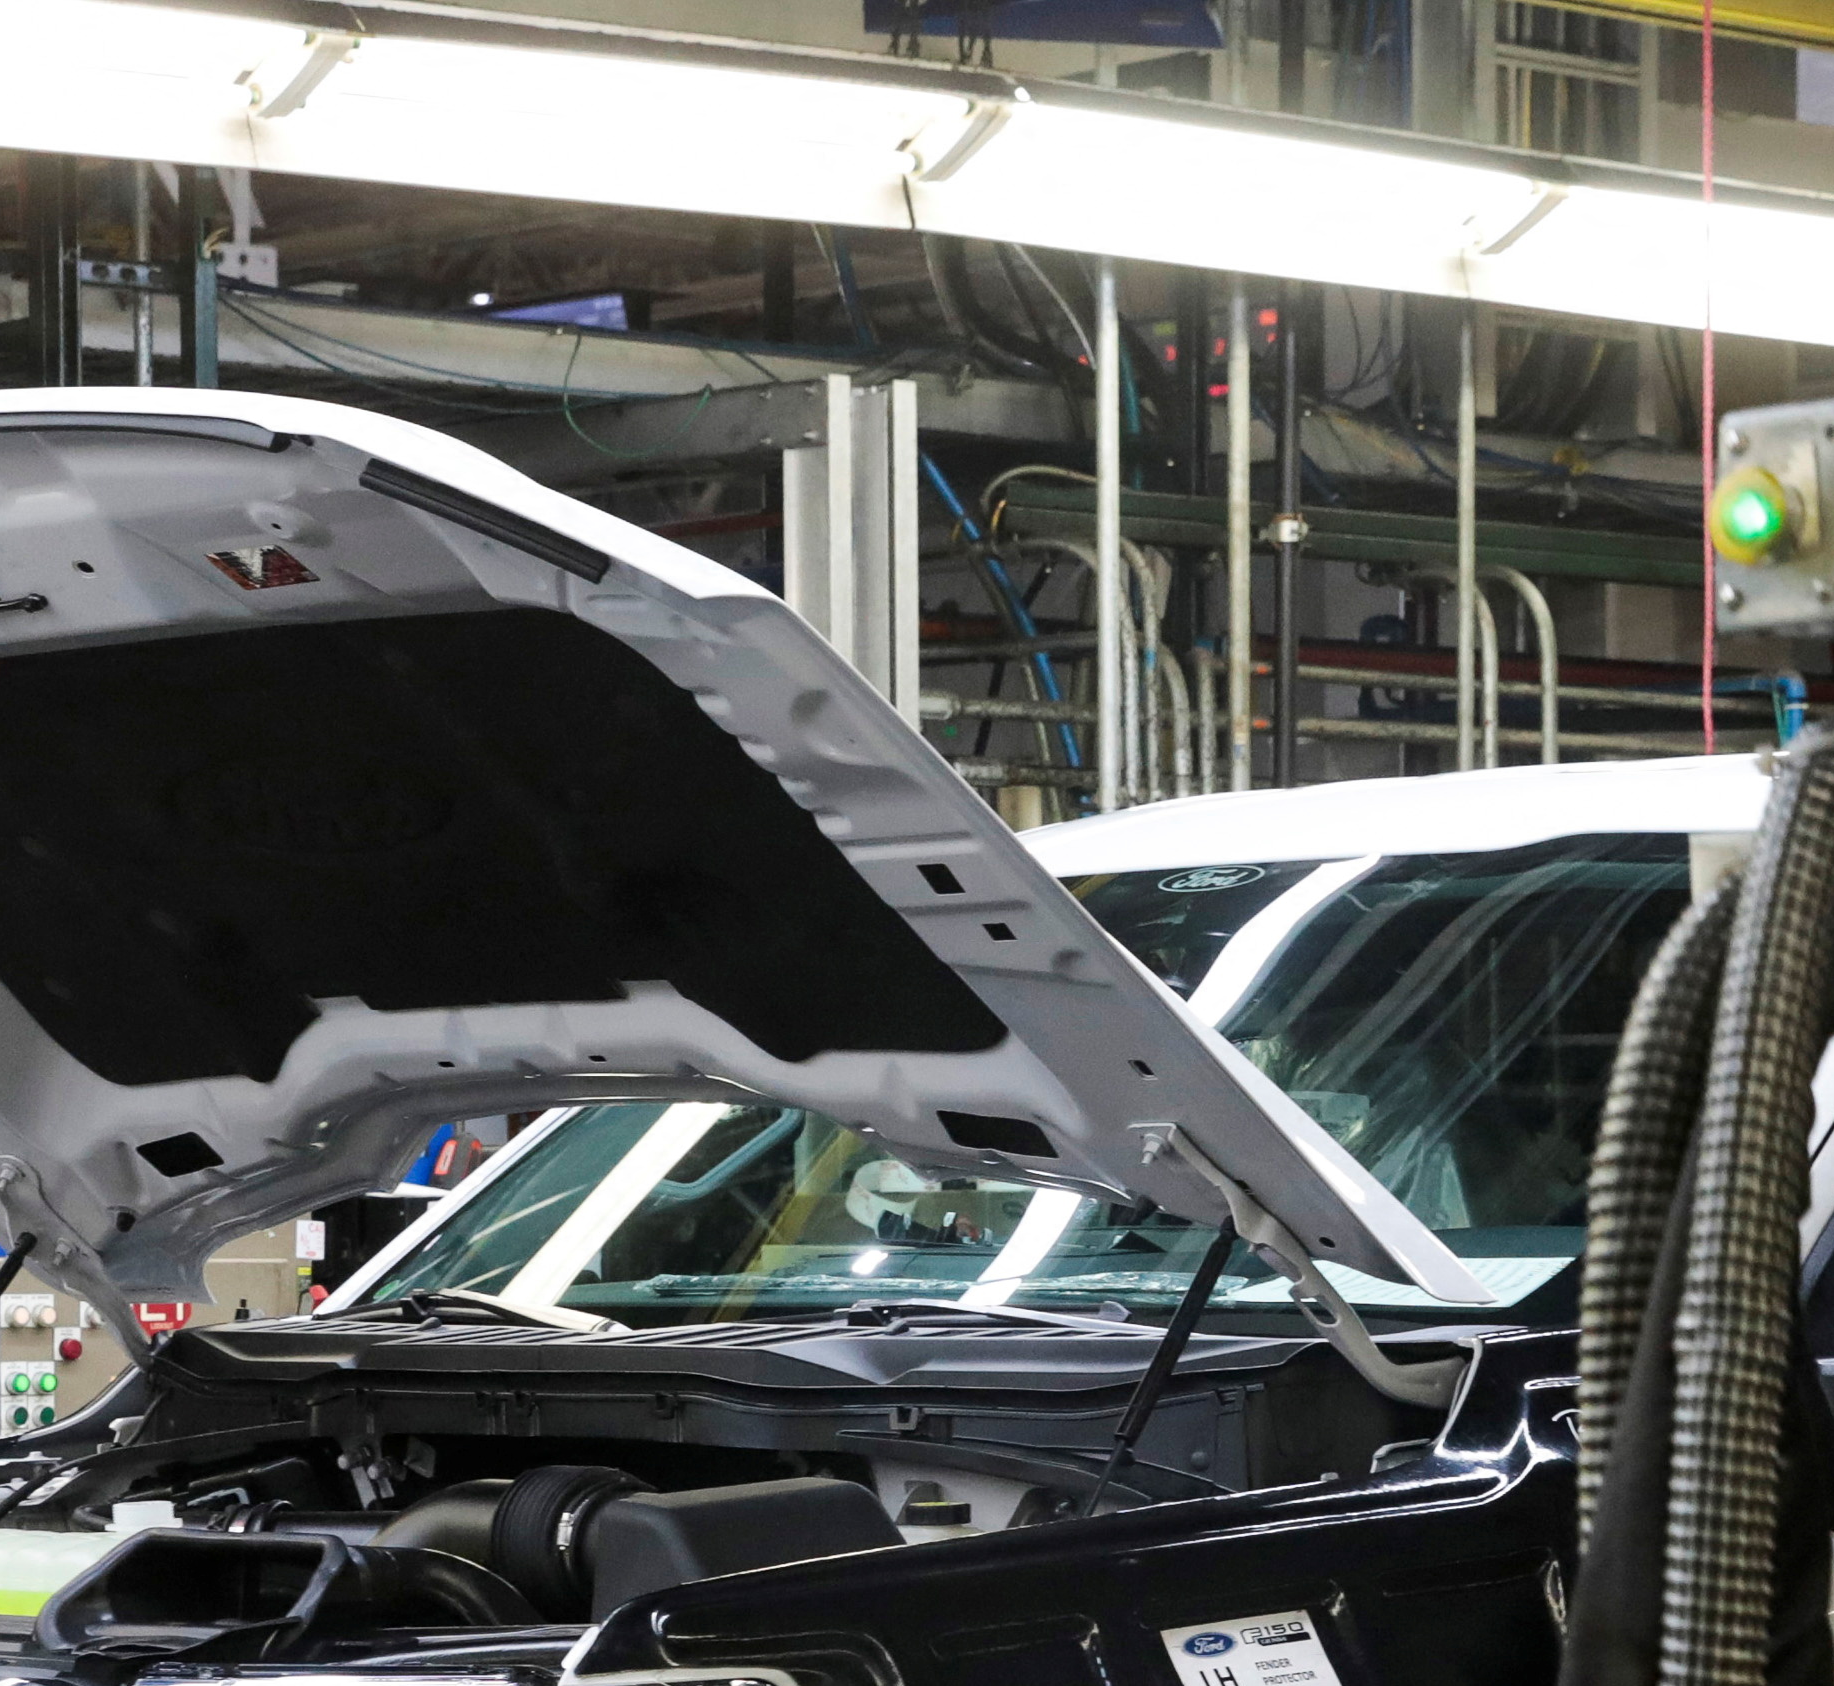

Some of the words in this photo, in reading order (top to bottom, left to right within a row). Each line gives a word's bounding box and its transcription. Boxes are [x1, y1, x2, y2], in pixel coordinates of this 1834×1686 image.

[1171, 868, 1249, 889] Ford
[1255, 1657, 1292, 1672] FENDER
[1263, 1670, 1318, 1686] PROTECTOR
